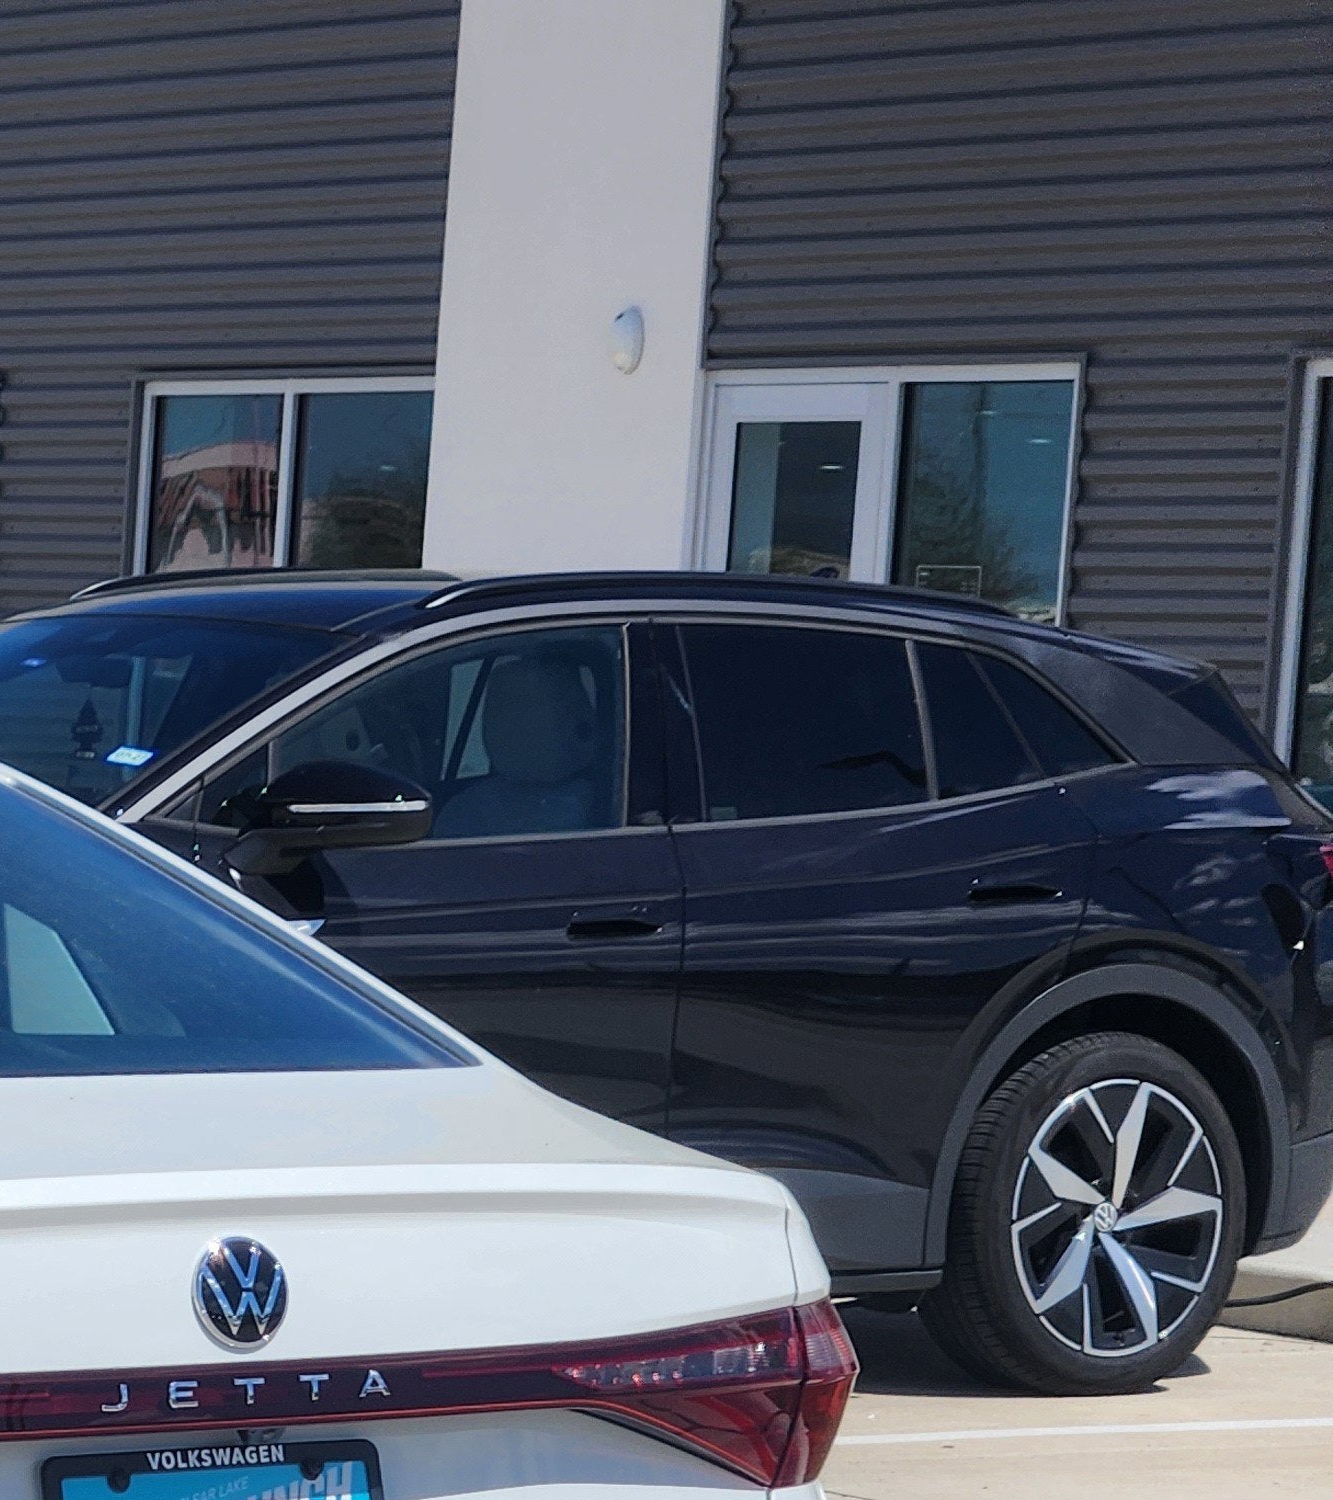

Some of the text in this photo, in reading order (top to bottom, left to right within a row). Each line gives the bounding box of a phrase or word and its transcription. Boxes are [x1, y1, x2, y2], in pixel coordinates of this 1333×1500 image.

[101, 1369, 391, 1413] JETTA
[147, 1444, 285, 1470] VOLKSWAGEN
[218, 1476, 250, 1498] LAKE
